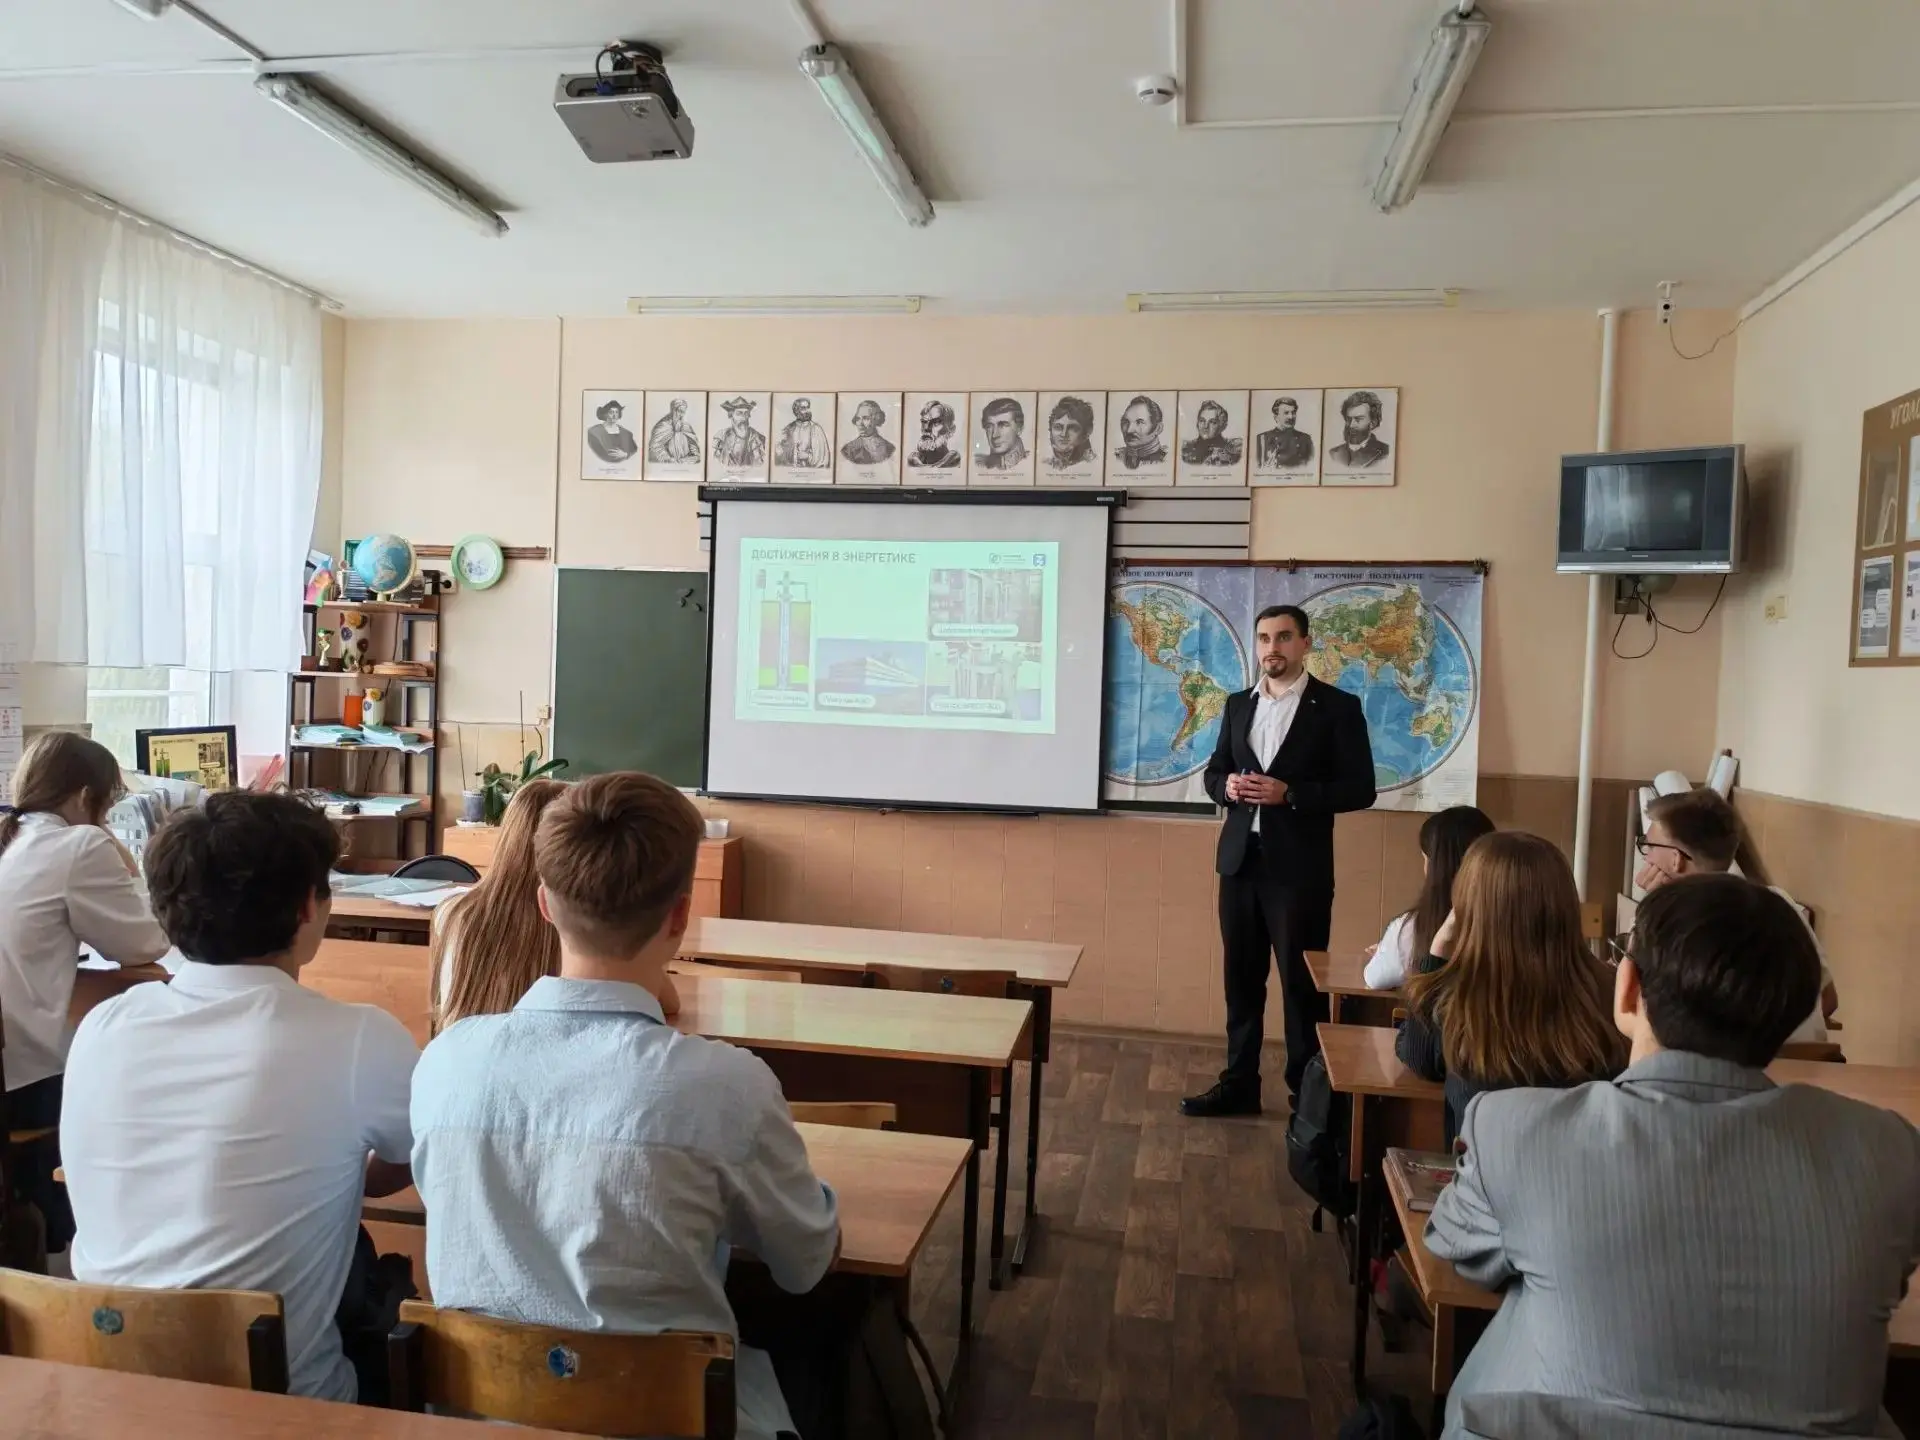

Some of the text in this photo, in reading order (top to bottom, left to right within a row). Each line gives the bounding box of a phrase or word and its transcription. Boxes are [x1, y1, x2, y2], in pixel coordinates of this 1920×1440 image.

[751, 549, 917, 564] ДОСТИЖЕНИЯ В ЭНЕРГЕТИКЕ
